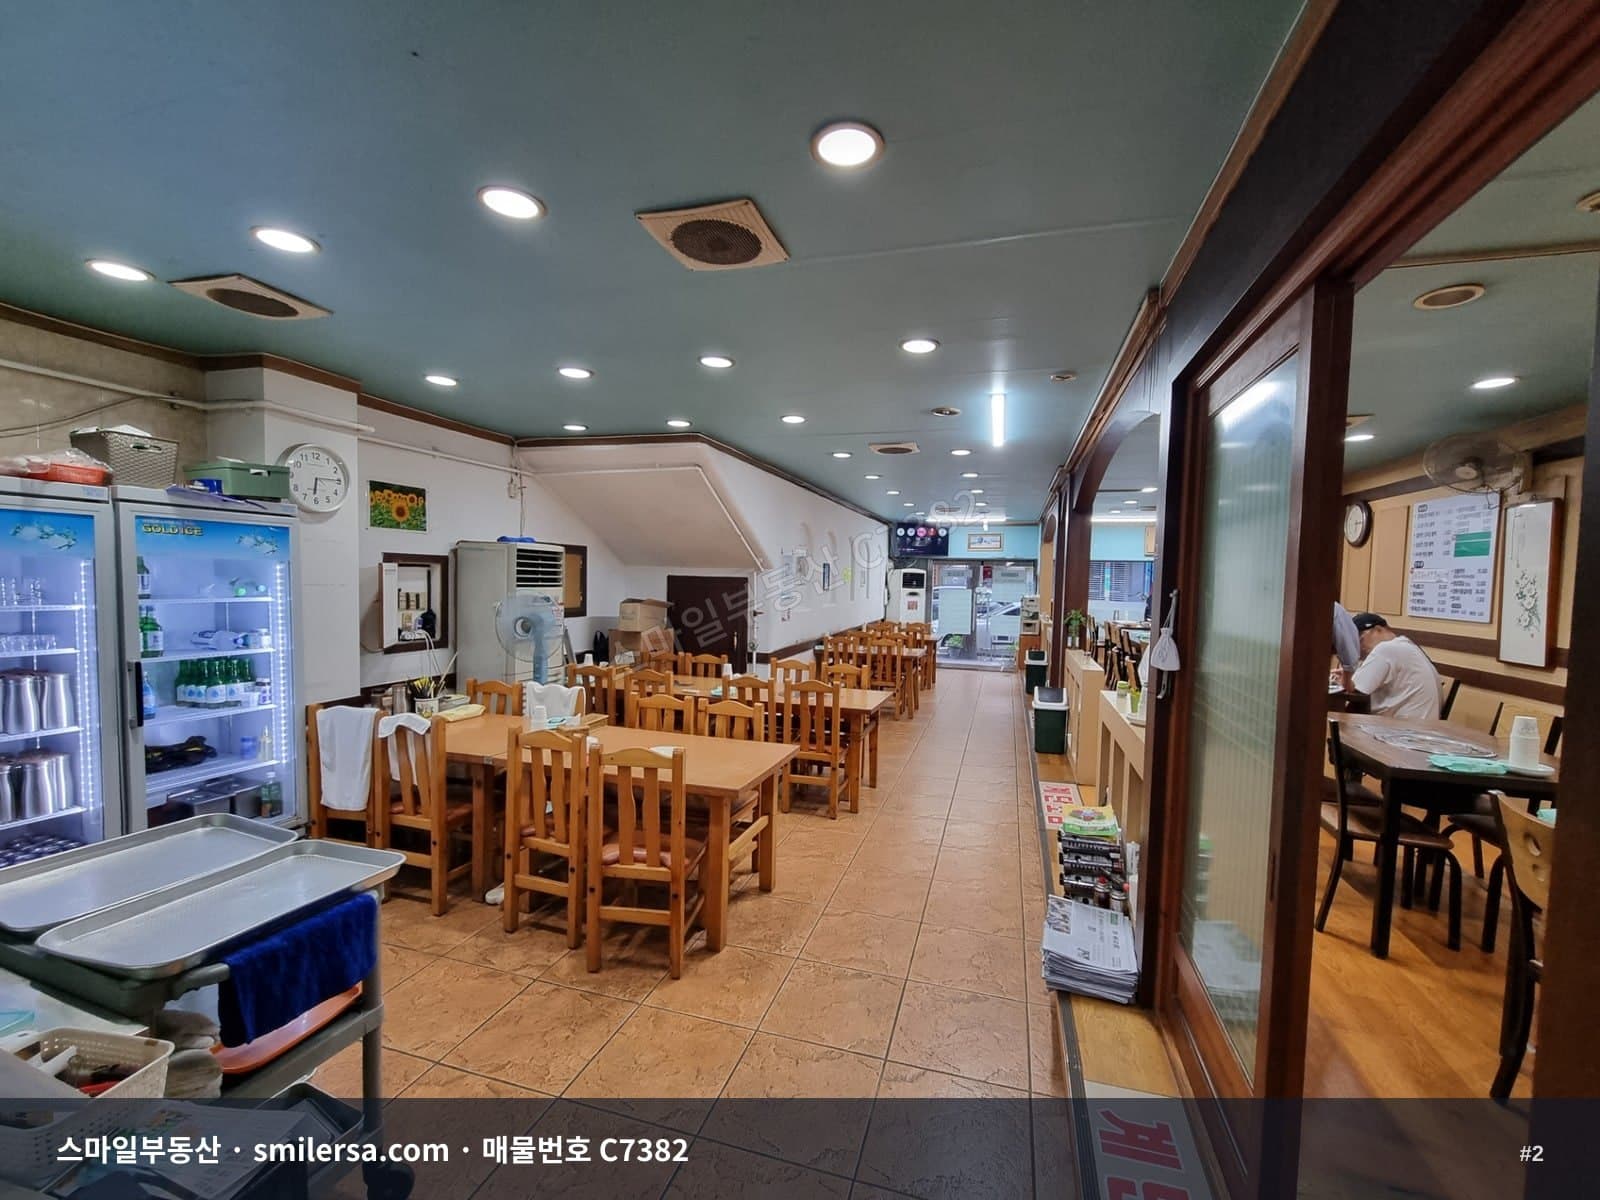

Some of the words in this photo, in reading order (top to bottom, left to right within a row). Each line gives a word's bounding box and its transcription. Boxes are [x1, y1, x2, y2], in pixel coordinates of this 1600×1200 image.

[311, 452, 321, 461] 12
[333, 466, 338, 474] 2
[302, 492, 308, 500] 7
[142, 523, 179, 535] GOLD
